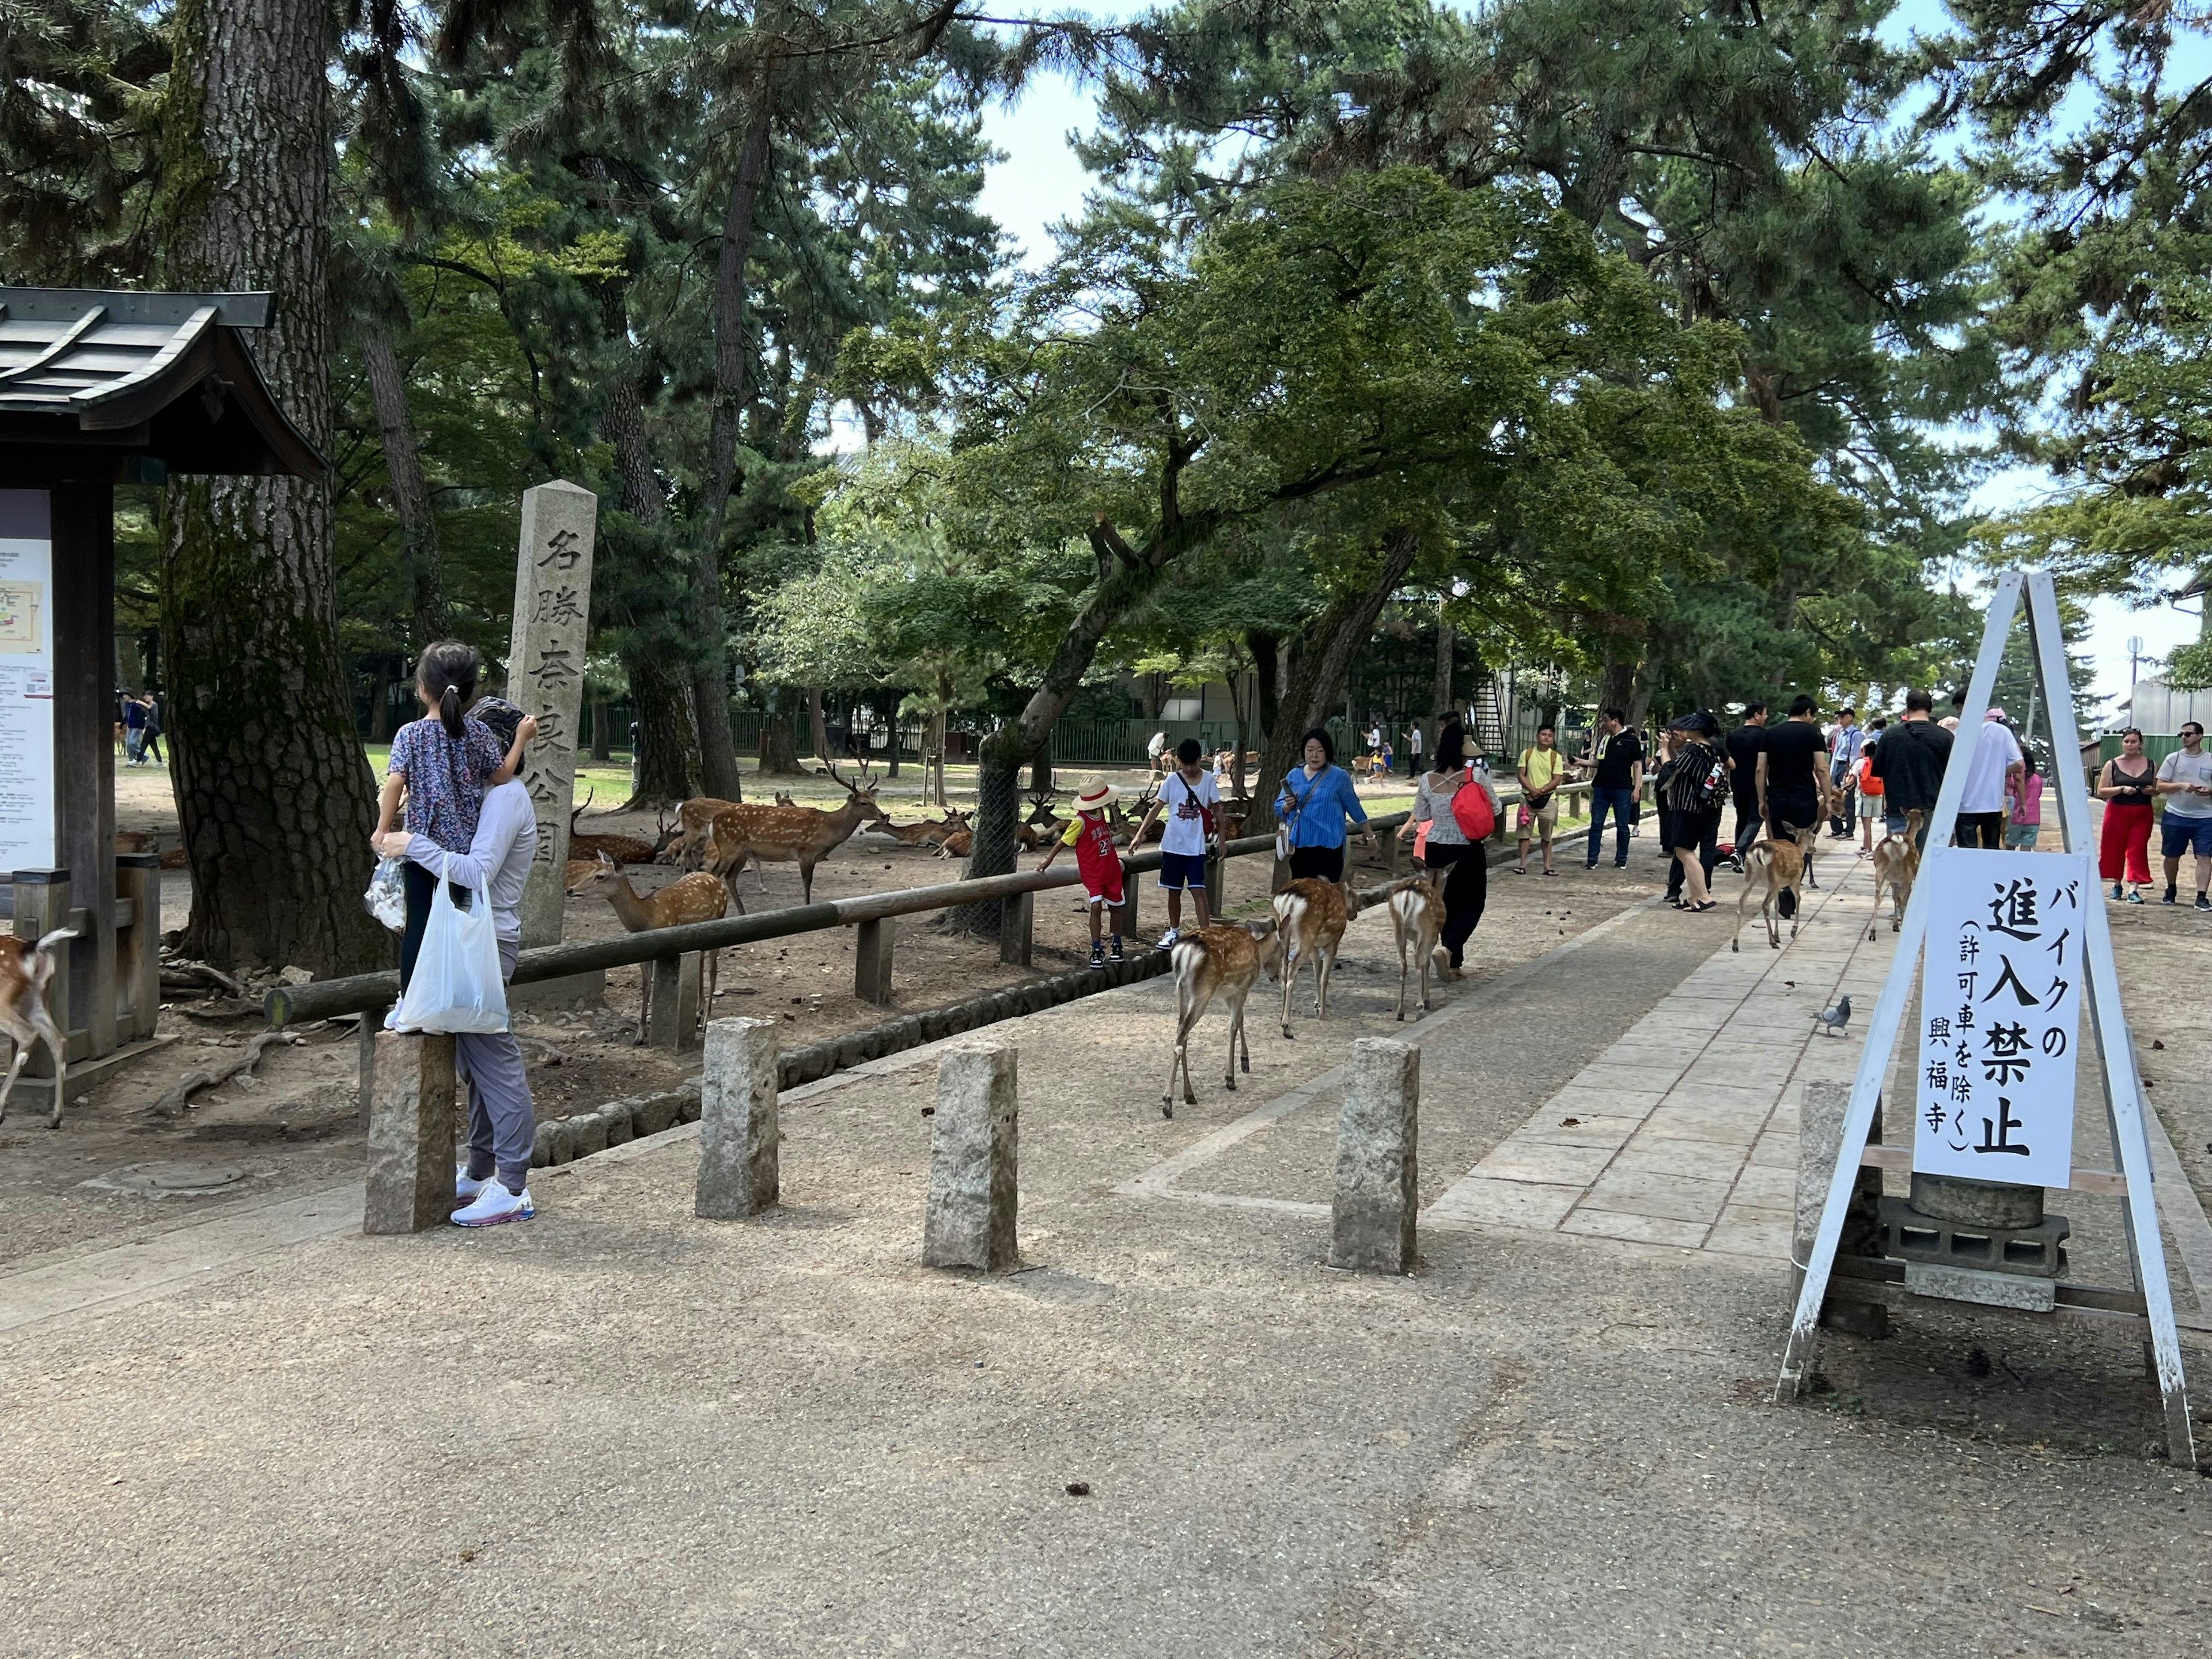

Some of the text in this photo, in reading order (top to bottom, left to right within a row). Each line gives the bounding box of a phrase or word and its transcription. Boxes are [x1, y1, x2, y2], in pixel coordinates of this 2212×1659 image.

[525, 529, 584, 865] 名勝奈良公園
[1924, 1017, 1951, 1134] 興福寺
[1948, 920, 1981, 1151] （許可車を除く）
[1973, 877, 2041, 1156] 進入禁止
[2042, 880, 2078, 1058] バイクの
